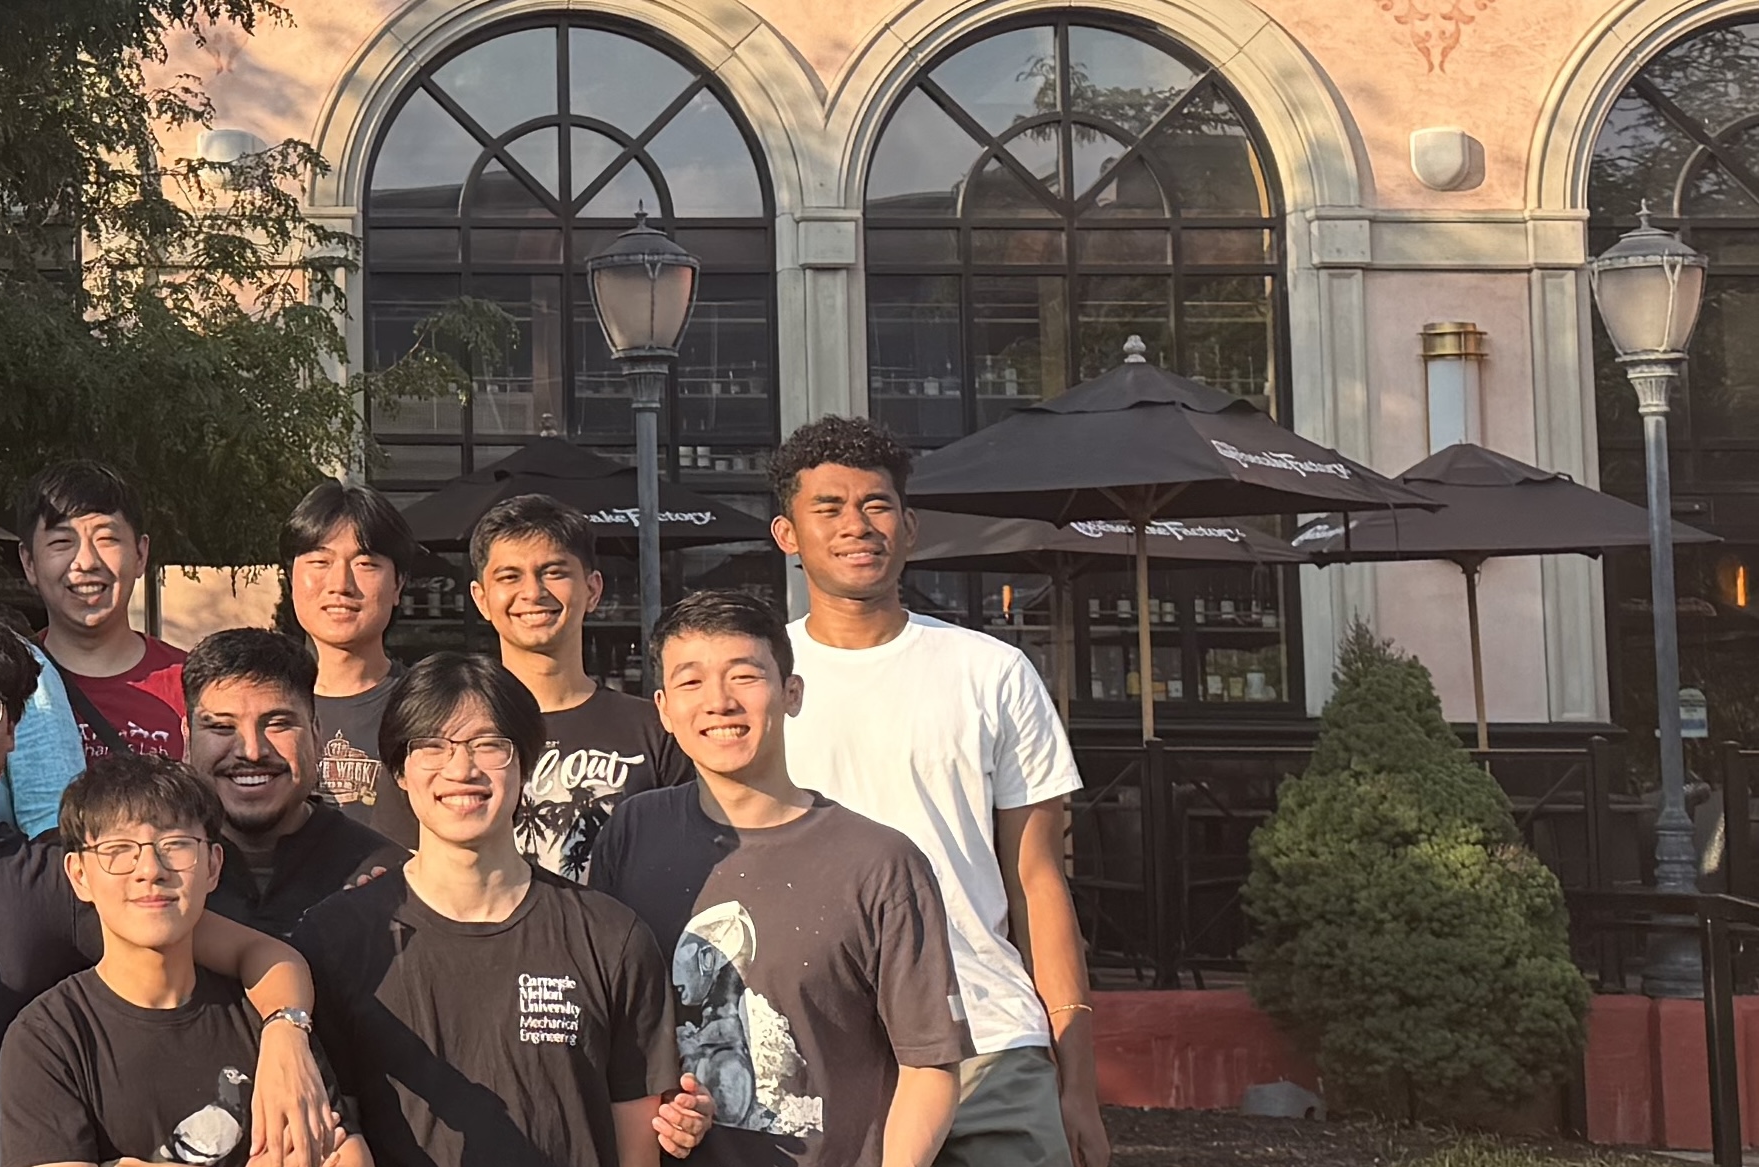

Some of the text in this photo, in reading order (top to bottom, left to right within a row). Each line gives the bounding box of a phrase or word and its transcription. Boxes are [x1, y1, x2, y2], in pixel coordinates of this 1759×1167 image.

[560, 749, 645, 789] Out
[518, 974, 576, 990] Carnegie
[519, 987, 563, 1000] Mellon
[520, 1001, 581, 1018] University
